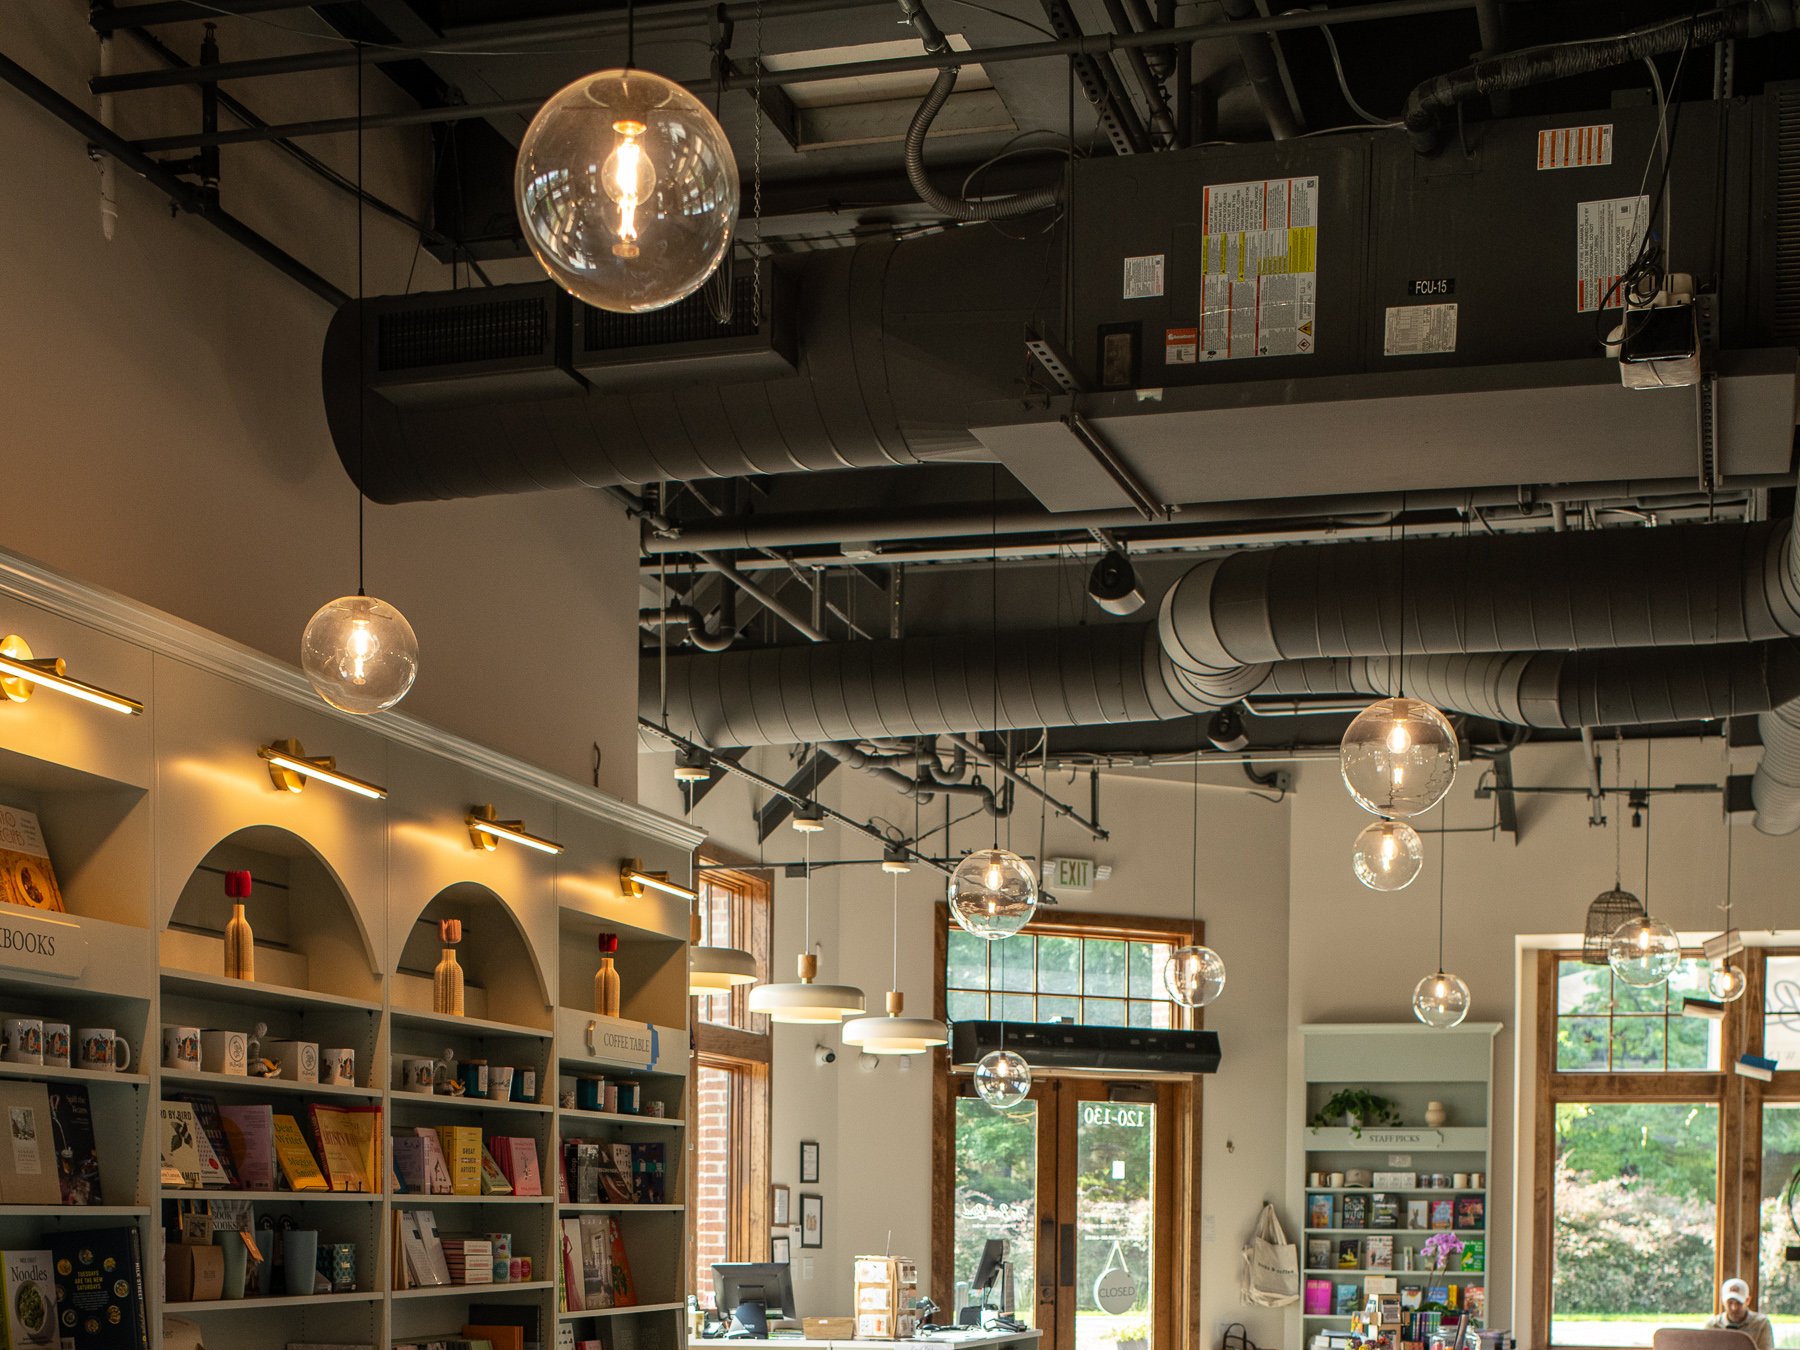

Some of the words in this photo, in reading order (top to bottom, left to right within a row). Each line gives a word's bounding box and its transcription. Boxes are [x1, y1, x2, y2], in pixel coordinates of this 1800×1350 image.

[1415, 280, 1447, 294] FCU-15
[1060, 860, 1089, 887] EXIT
[603, 1032, 629, 1050] COFFEE
[629, 1036, 650, 1053] TABLE
[169, 1109, 176, 1119] BY
[177, 1110, 192, 1120] BIRD
[274, 1122, 293, 1133] Dear
[275, 1134, 304, 1145] Writer
[1369, 1134, 1394, 1143] STAFF
[1395, 1134, 1420, 1143] PICKS
[10, 1265, 48, 1281] Noodles
[1100, 1286, 1136, 1298] CLOSED
